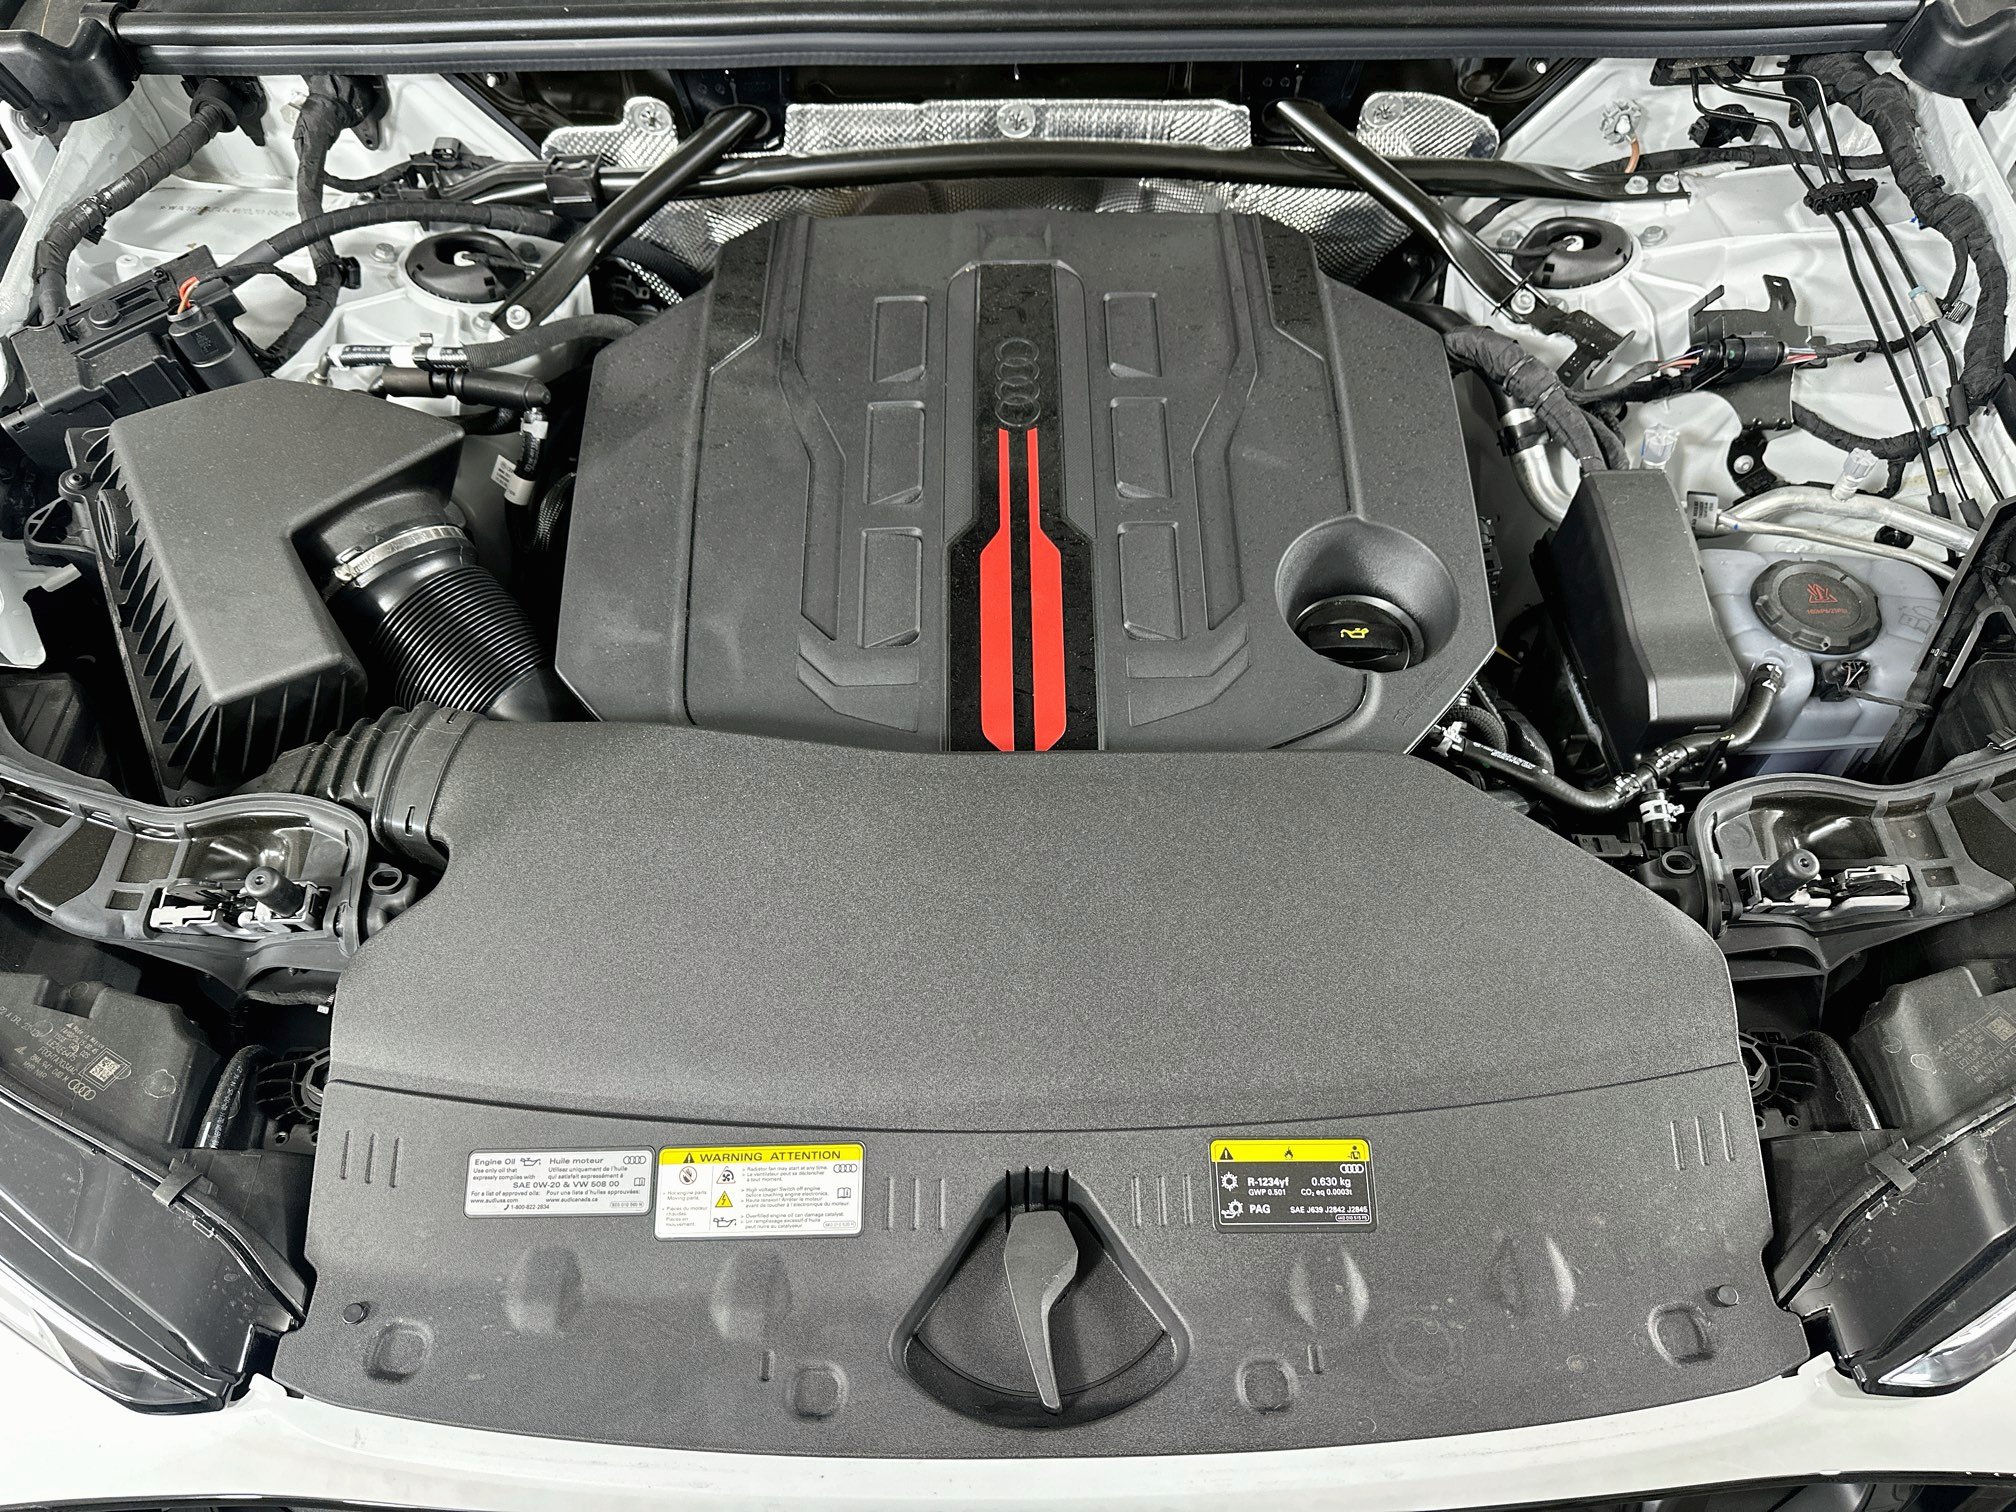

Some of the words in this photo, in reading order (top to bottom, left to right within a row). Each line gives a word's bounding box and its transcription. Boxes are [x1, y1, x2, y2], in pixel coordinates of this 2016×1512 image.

[700, 1153, 762, 1162] WARNING
[770, 1151, 840, 1160] ATTENTION
[1248, 1177, 1289, 1188] R-1234yf
[1311, 1177, 1337, 1186] 0.630
[1340, 1177, 1351, 1188] kg
[1250, 1204, 1270, 1213] PAG
